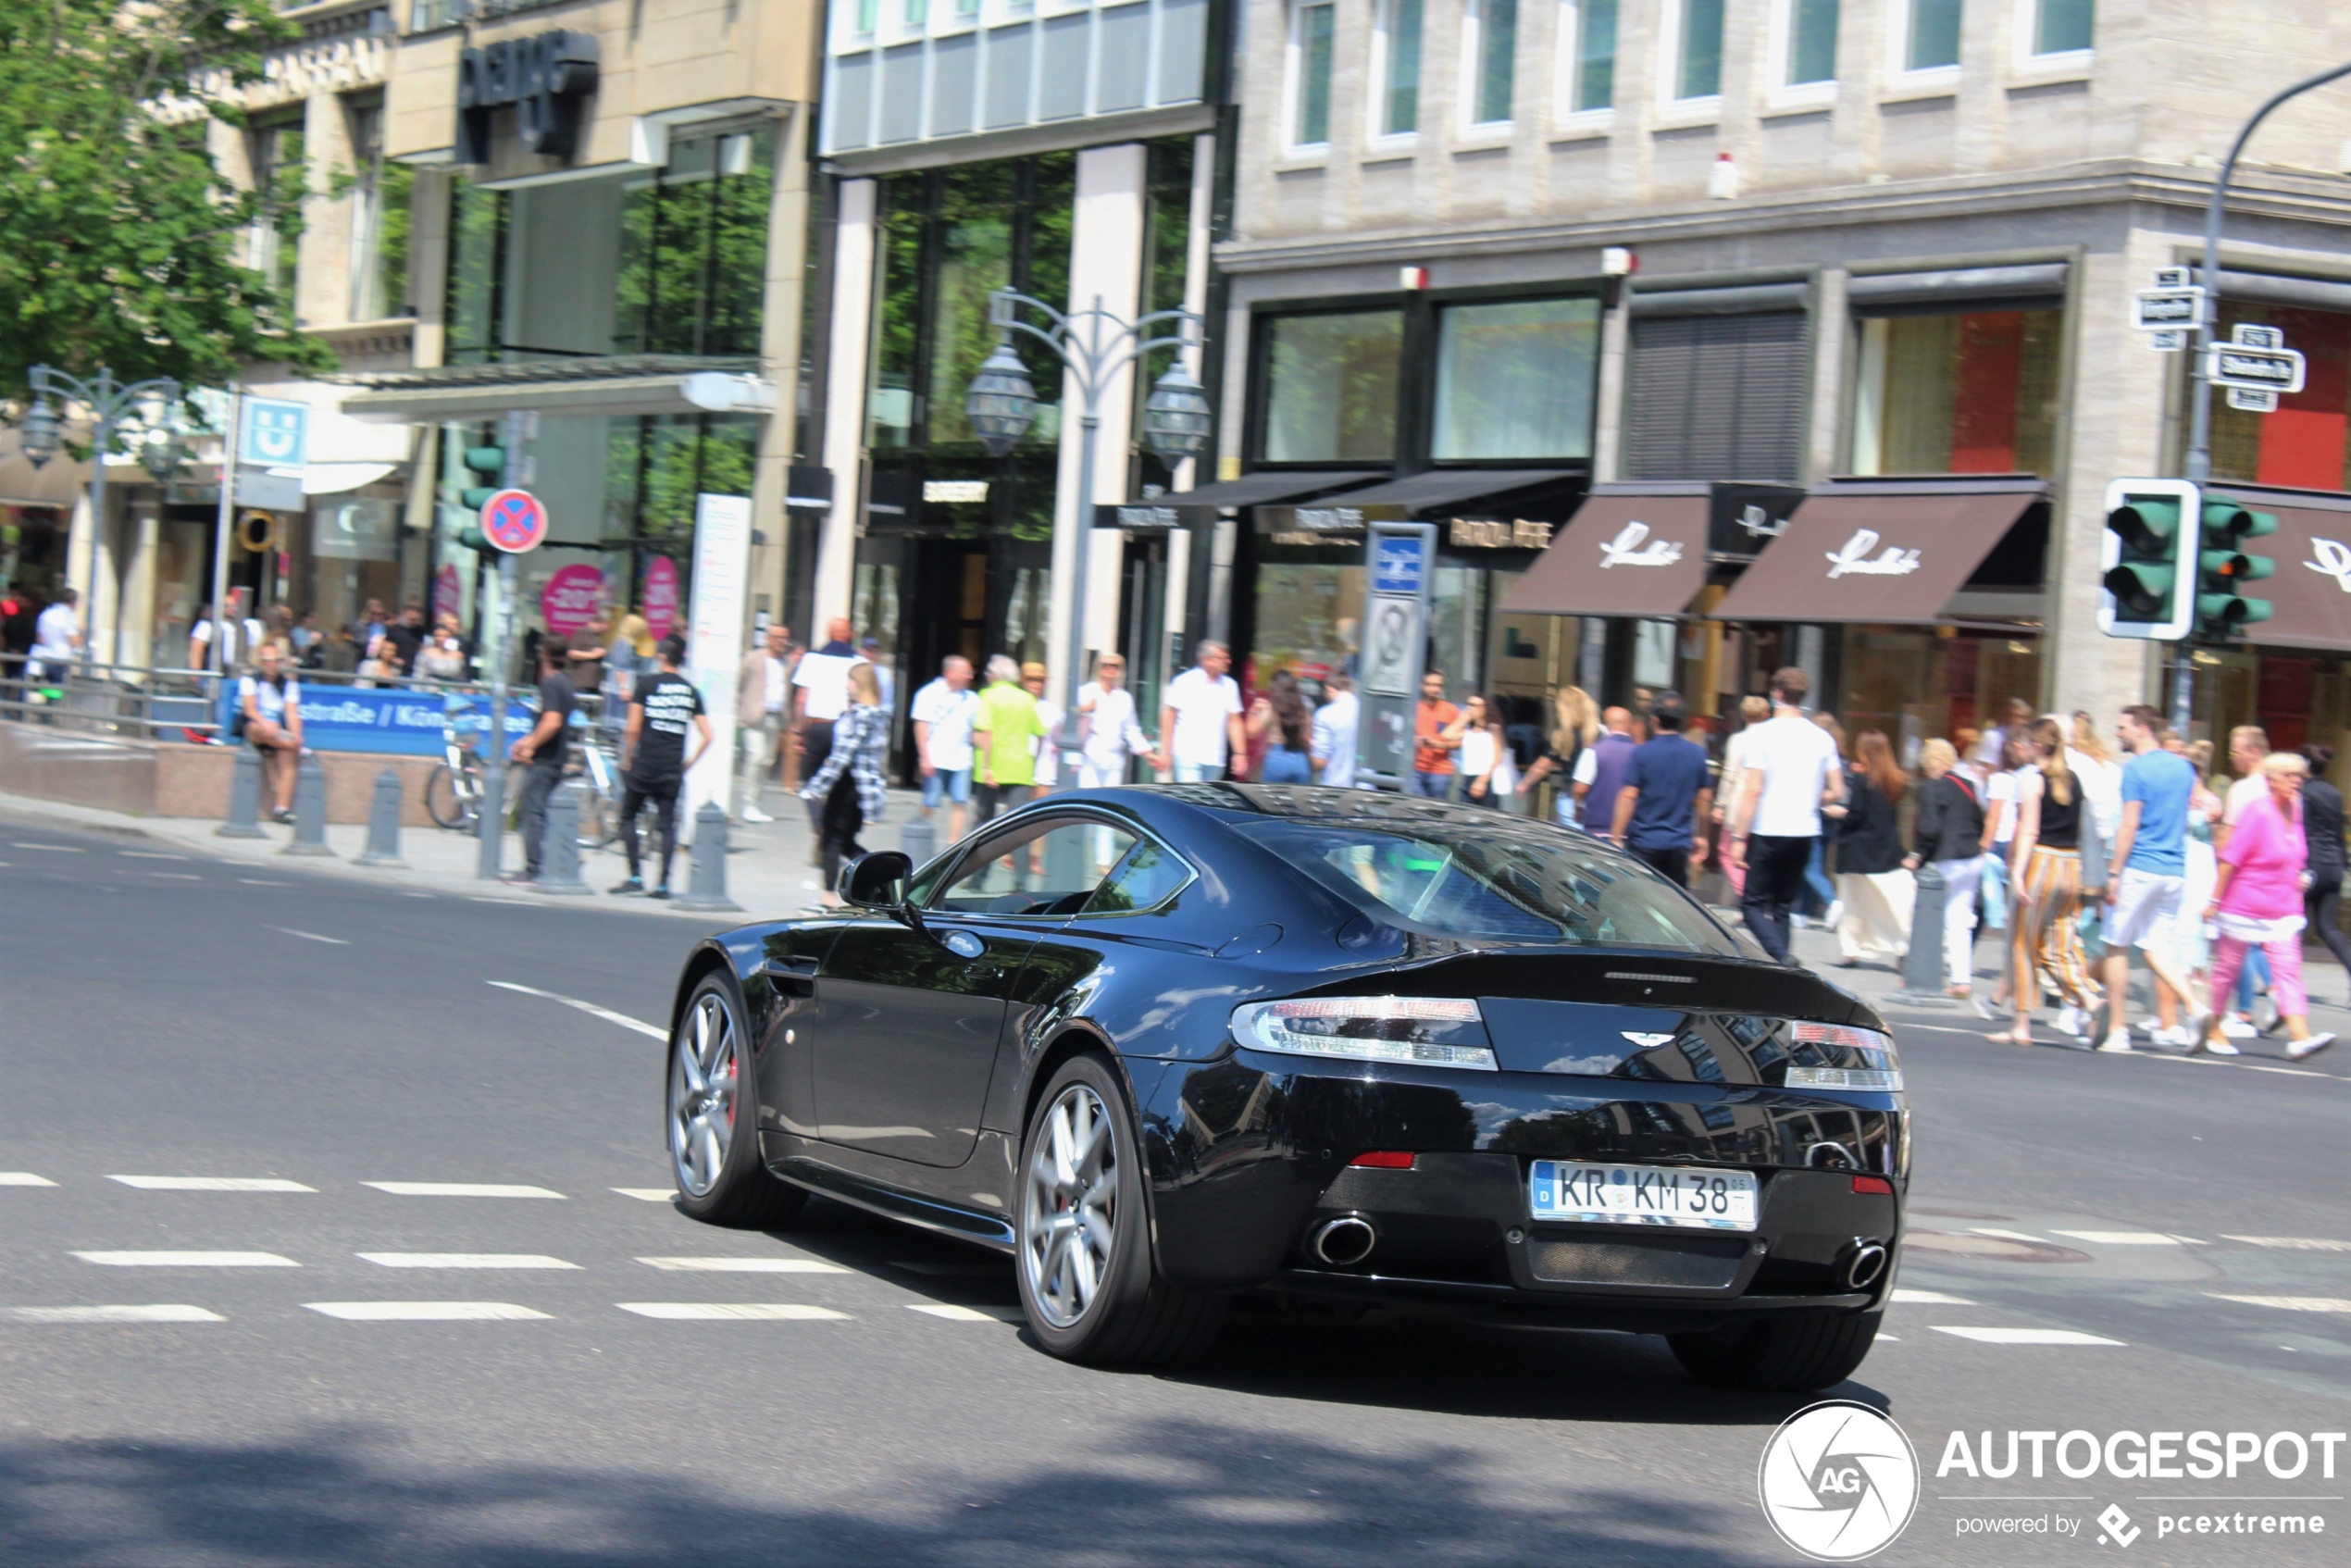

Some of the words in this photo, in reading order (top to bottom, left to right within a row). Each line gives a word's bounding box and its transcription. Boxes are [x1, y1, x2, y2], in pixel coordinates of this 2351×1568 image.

[1539, 1190, 1549, 1202] D
[1561, 1168, 1607, 1208] KR
[1634, 1171, 1679, 1212] KM
[1689, 1175, 1728, 1214] 38
